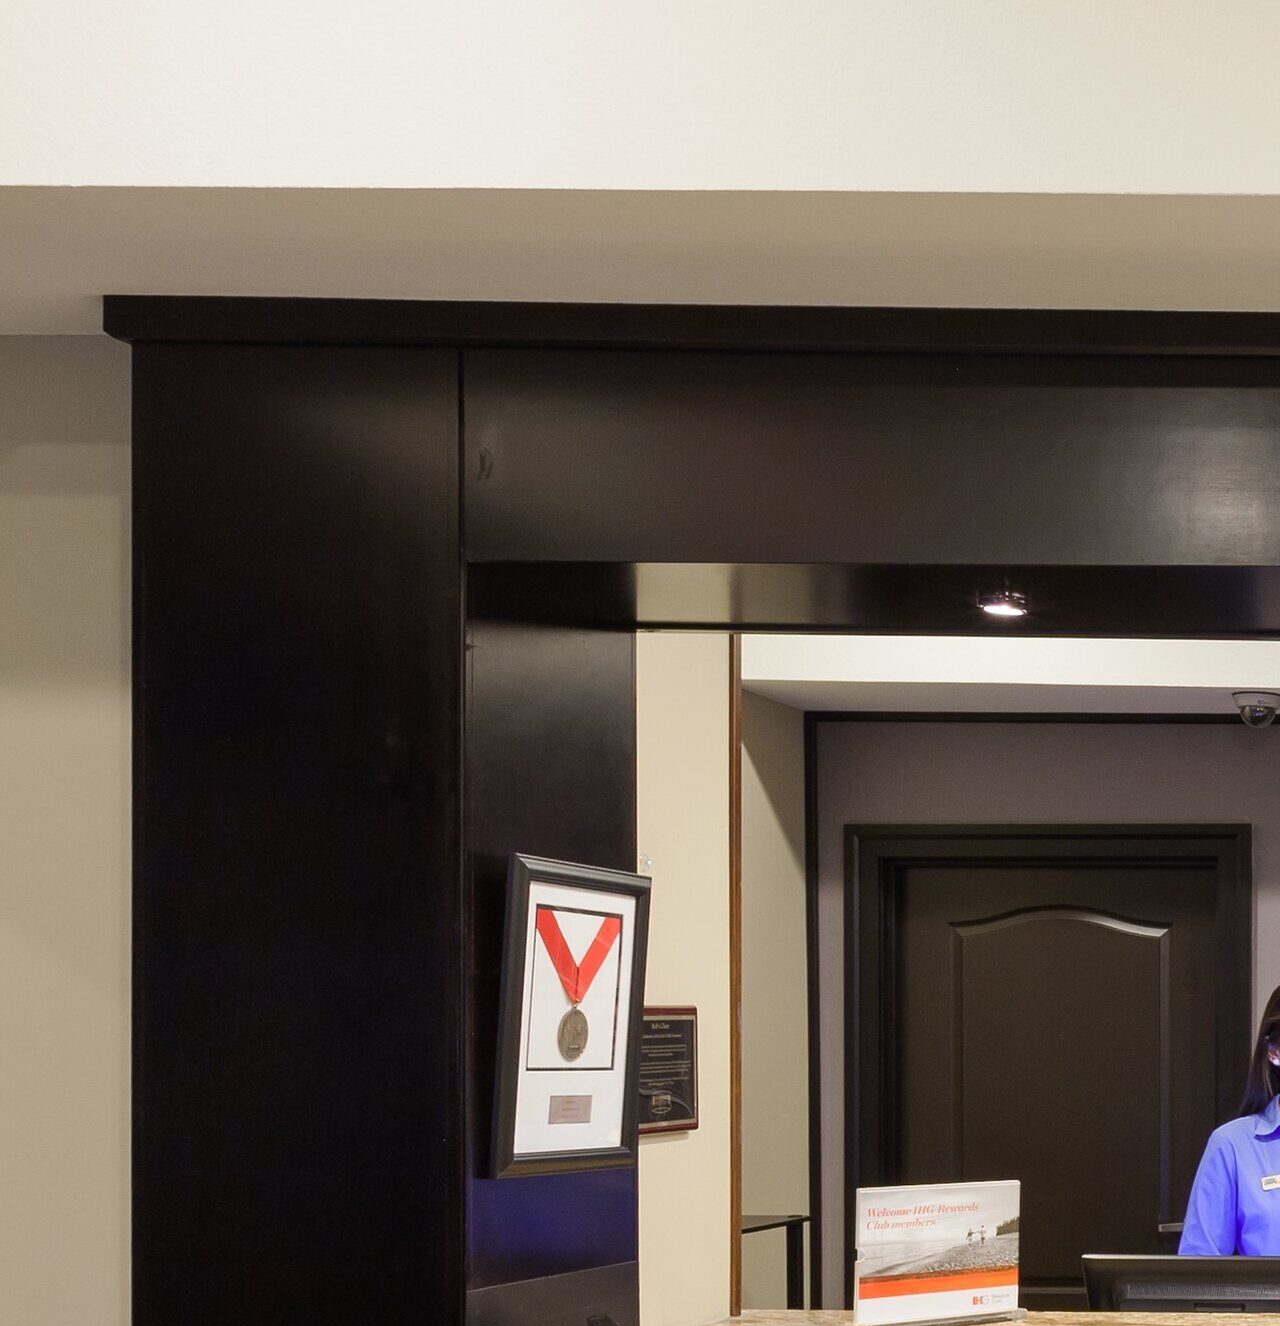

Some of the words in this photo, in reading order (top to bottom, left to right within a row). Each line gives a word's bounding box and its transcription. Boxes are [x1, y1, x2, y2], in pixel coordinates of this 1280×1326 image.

[866, 1208, 911, 1217] Welcome
[912, 1205, 934, 1215] IHG
[937, 1202, 979, 1213] Rewards
[866, 1220, 890, 1230] Club
[891, 1218, 937, 1229] members
